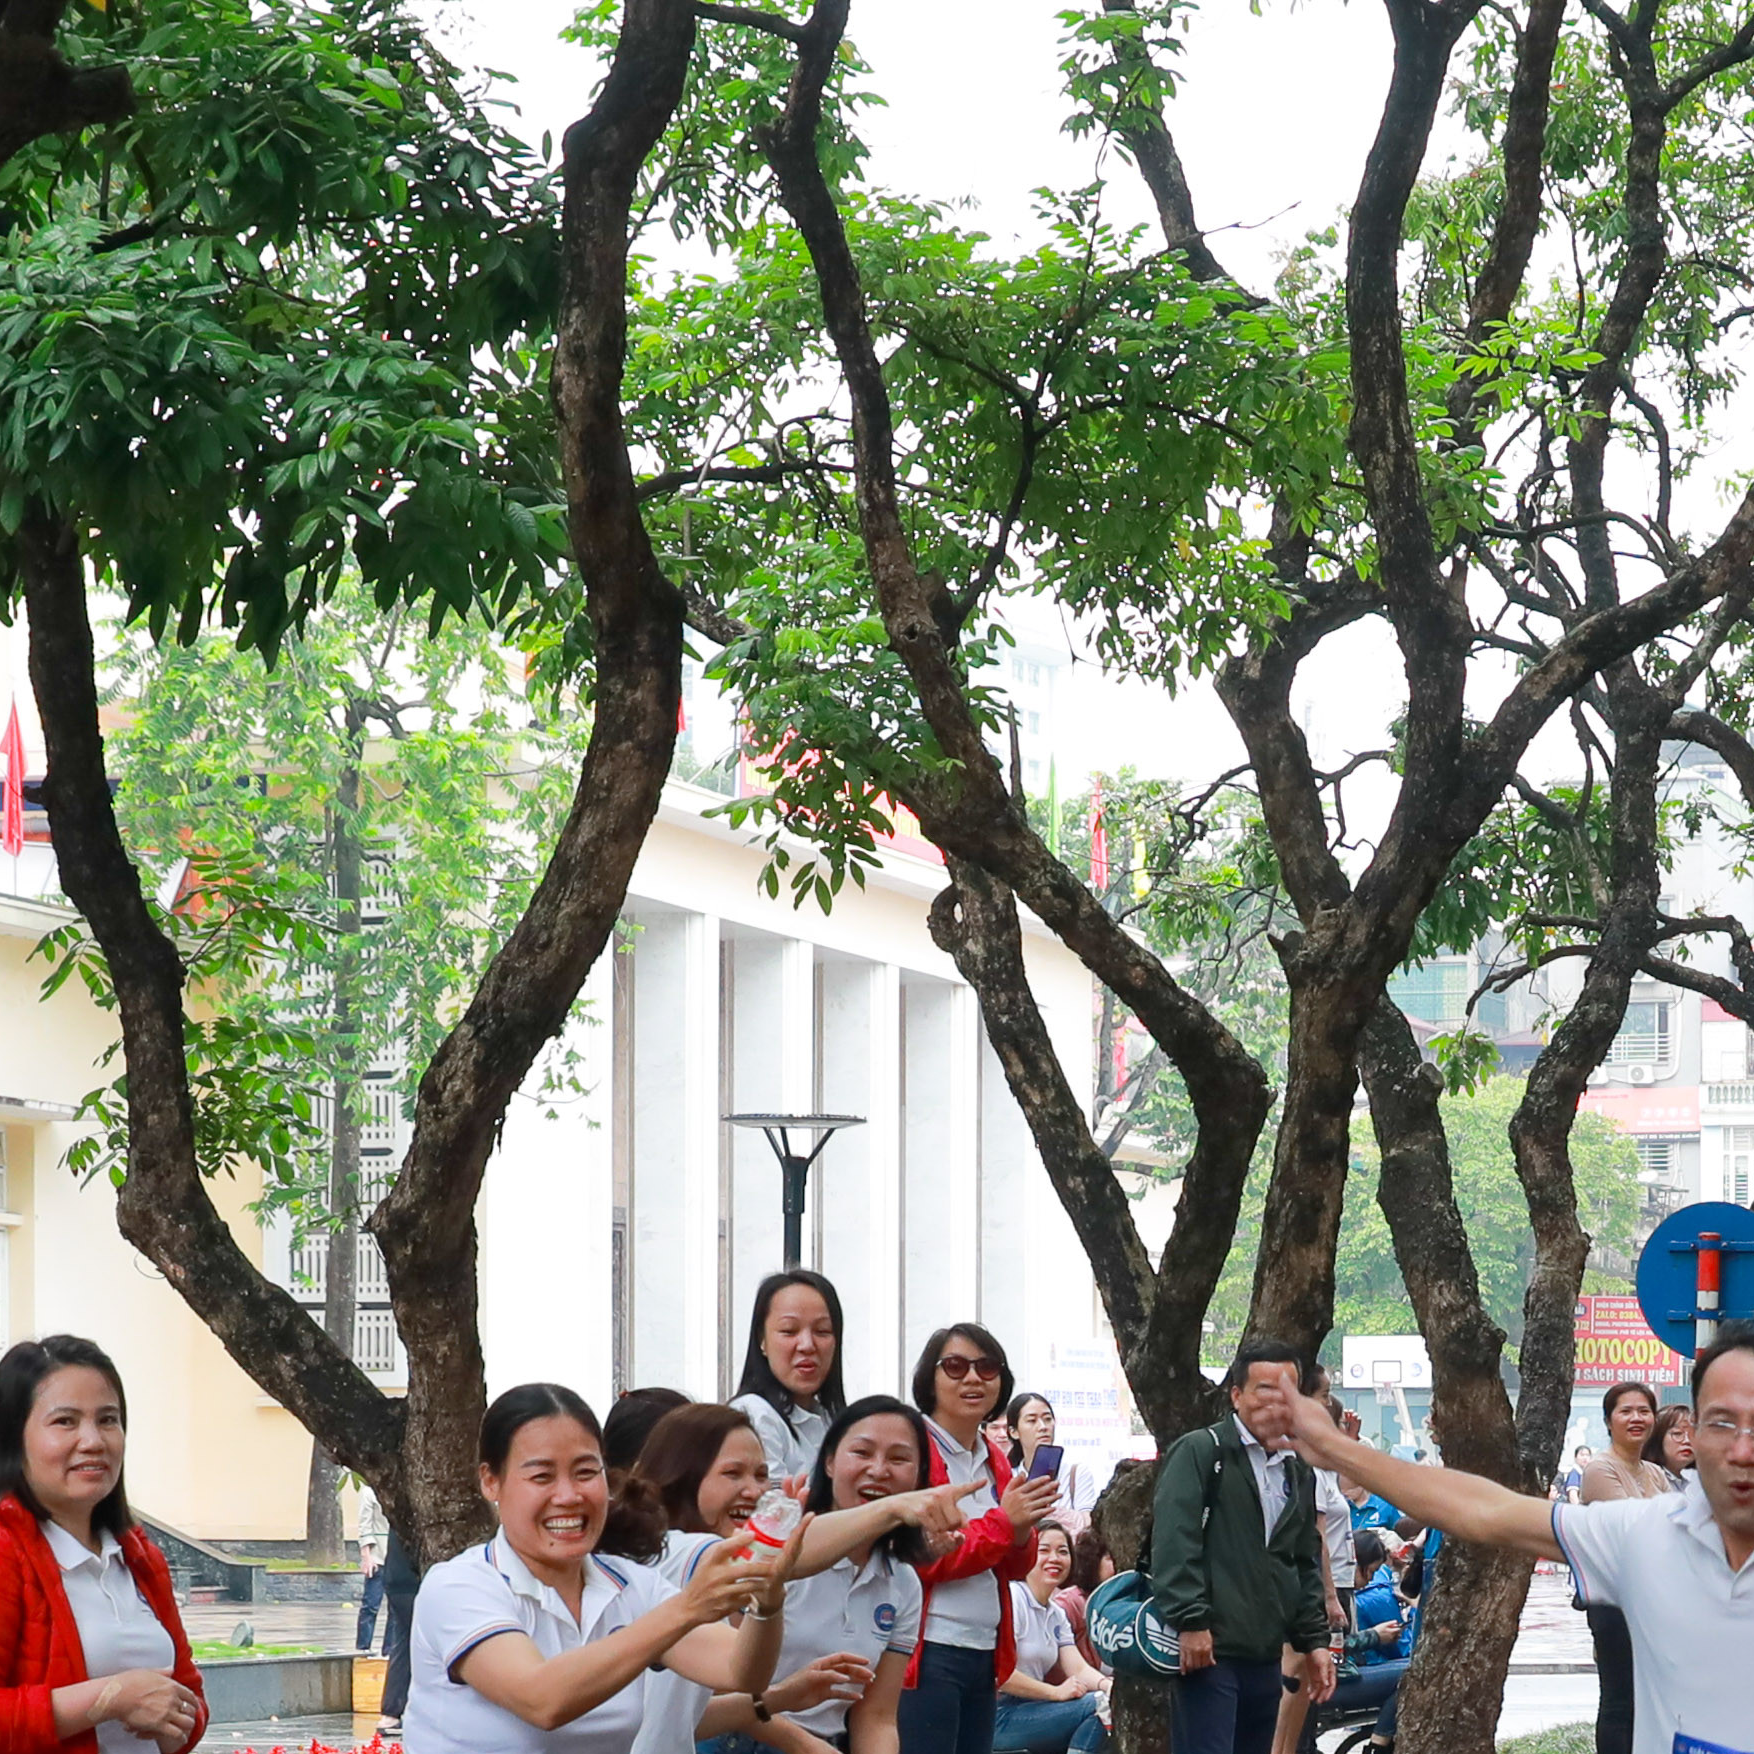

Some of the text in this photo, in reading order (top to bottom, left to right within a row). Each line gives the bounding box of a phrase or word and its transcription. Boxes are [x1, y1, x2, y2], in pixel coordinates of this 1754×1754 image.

[1574, 1337, 1671, 1366] HOTOCOPY
[1583, 1365, 1614, 1382] SÁCH
[1617, 1367, 1645, 1382] SINH
[1648, 1366, 1675, 1382] VIÊN
